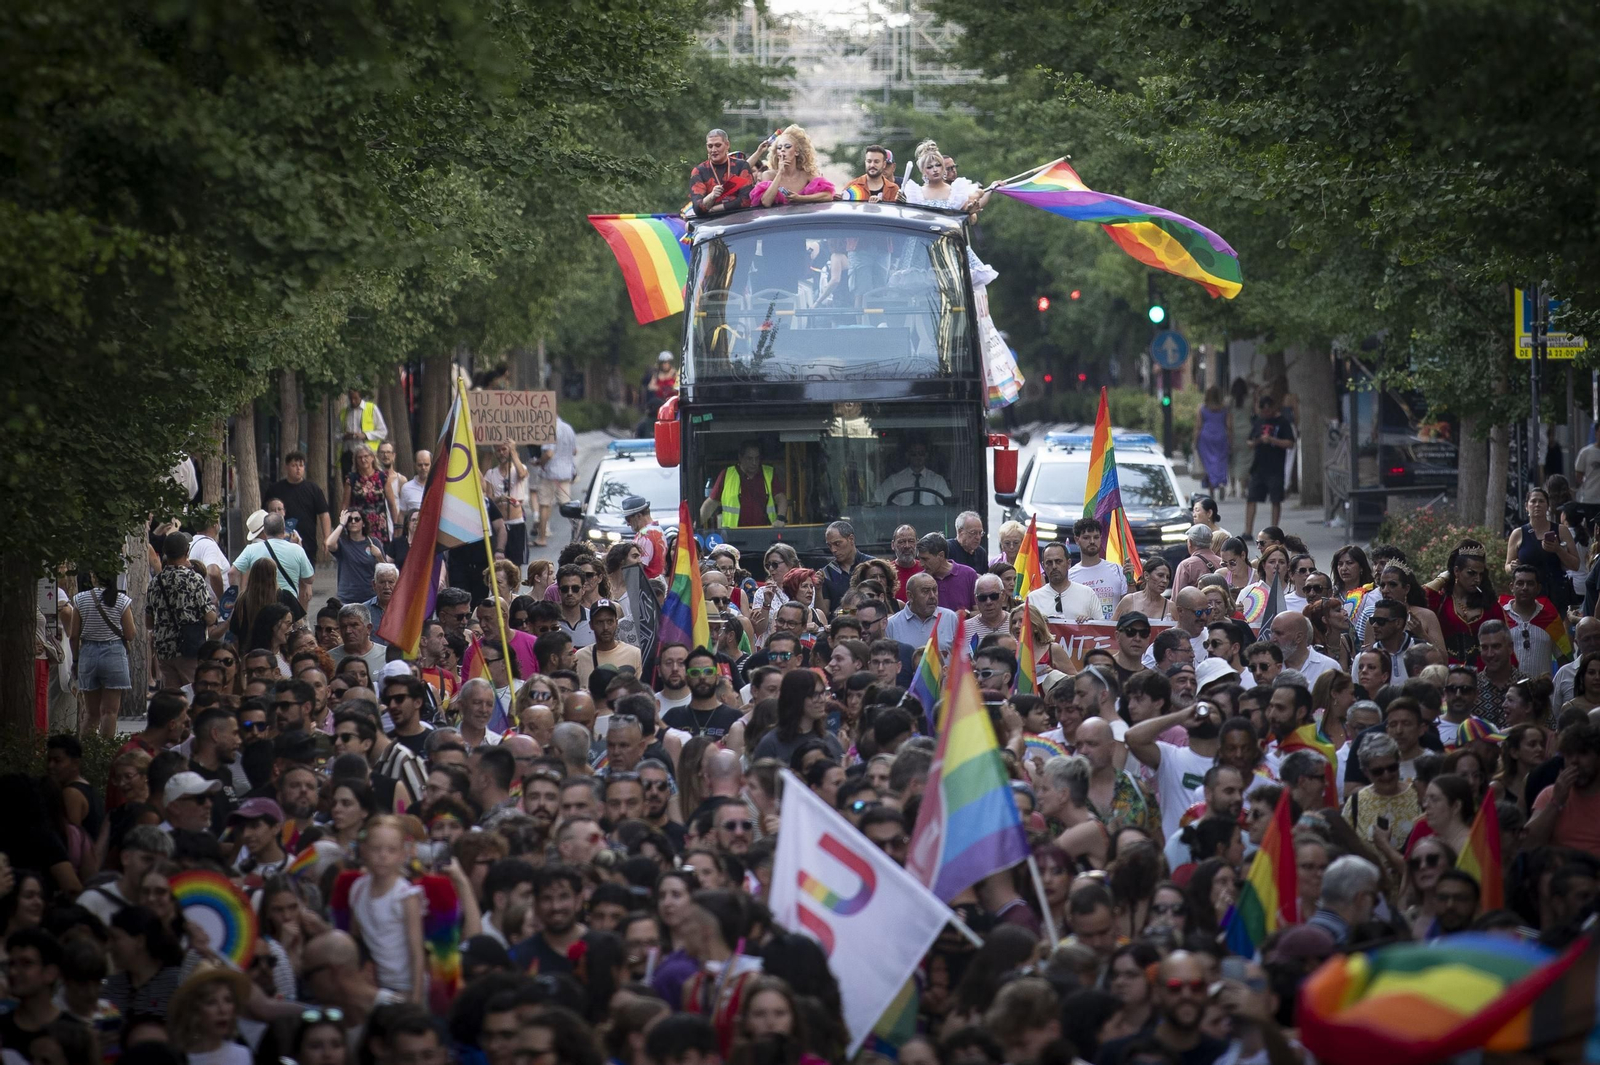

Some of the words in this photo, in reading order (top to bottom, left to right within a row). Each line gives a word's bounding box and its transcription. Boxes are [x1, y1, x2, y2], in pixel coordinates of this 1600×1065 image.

[472, 392, 489, 406] TU
[470, 409, 553, 424] MASCULINIDAD
[485, 426, 502, 441] NOS
[505, 425, 556, 442] INTERESA
[1052, 634, 1111, 660] NTE
